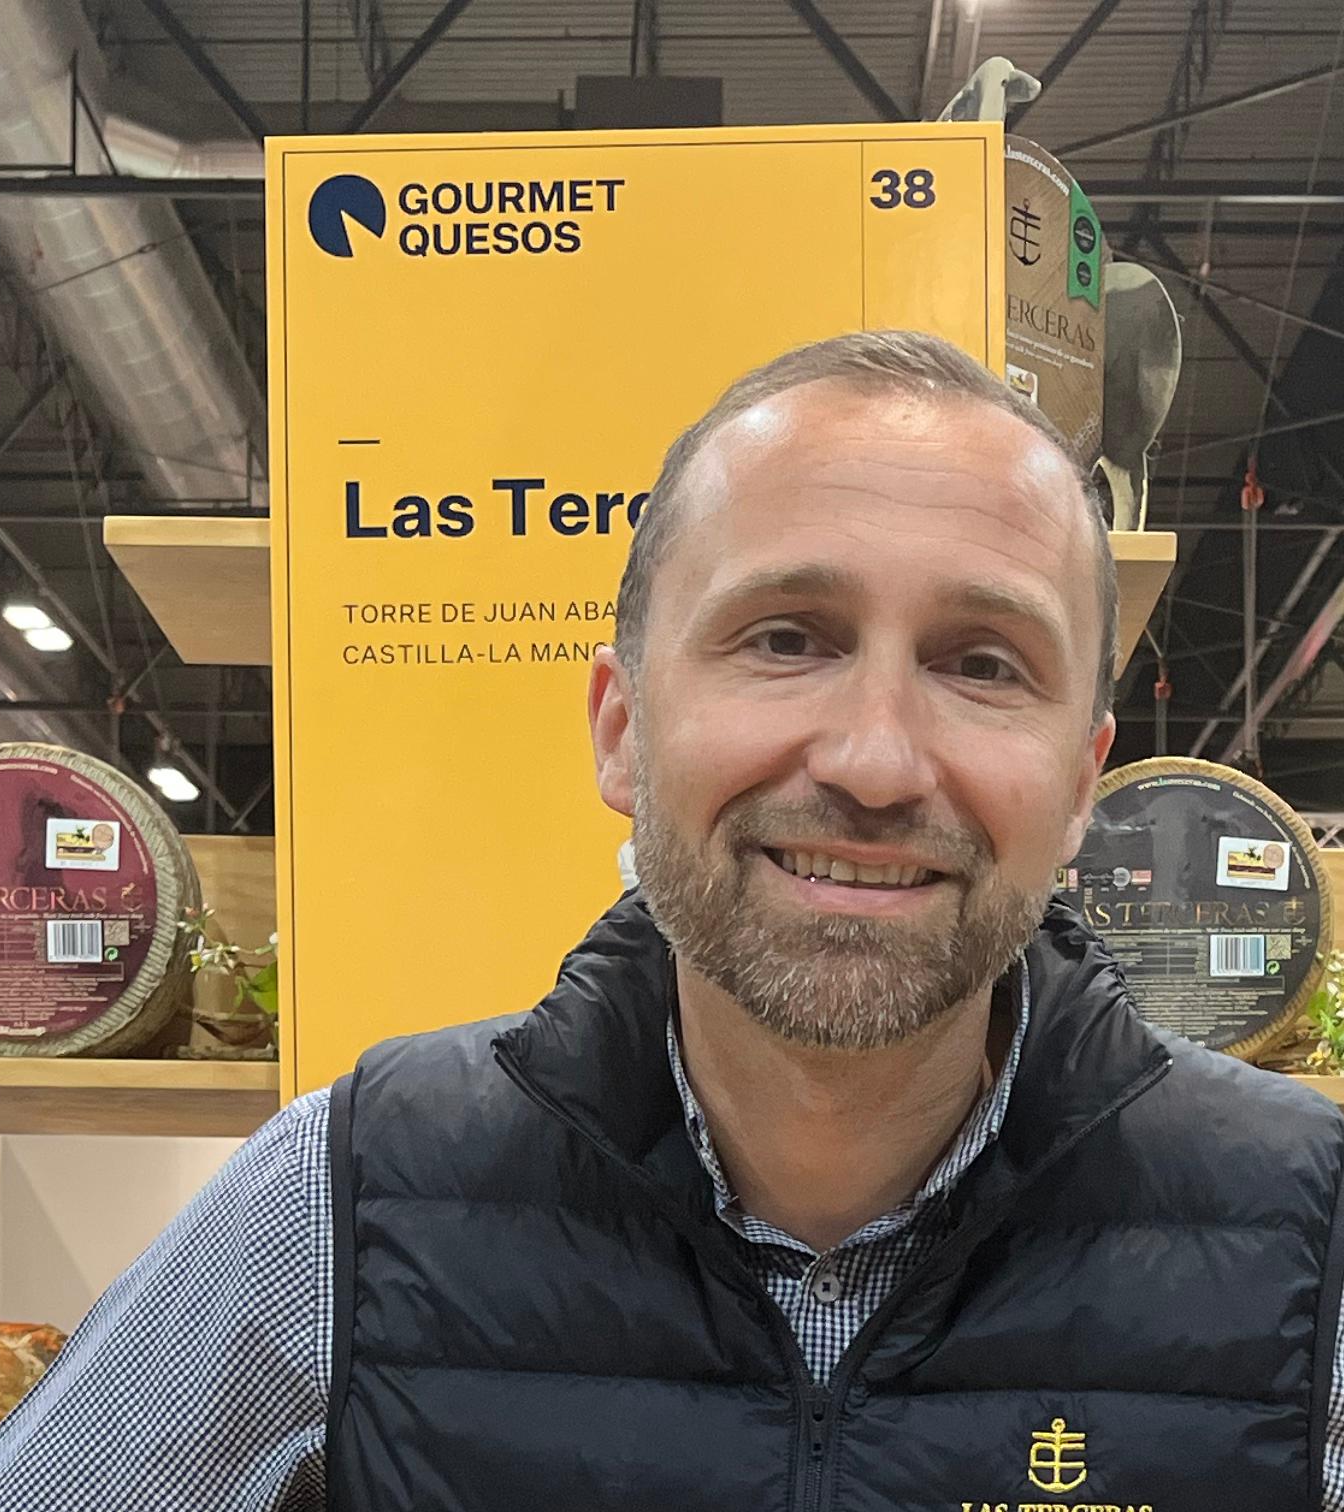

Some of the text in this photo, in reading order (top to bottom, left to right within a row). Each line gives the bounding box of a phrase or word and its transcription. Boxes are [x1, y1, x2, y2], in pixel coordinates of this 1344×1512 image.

[399, 179, 625, 215] GOURMET
[869, 169, 936, 209] 38
[399, 221, 581, 257] QUESOS
[345, 481, 474, 538] Las
[342, 604, 431, 624] TORRE
[442, 603, 475, 623] DE
[484, 602, 555, 623] JUAN
[343, 643, 522, 664] CASTILLA-LA
[1114, 901, 1270, 927] TERCERAS
